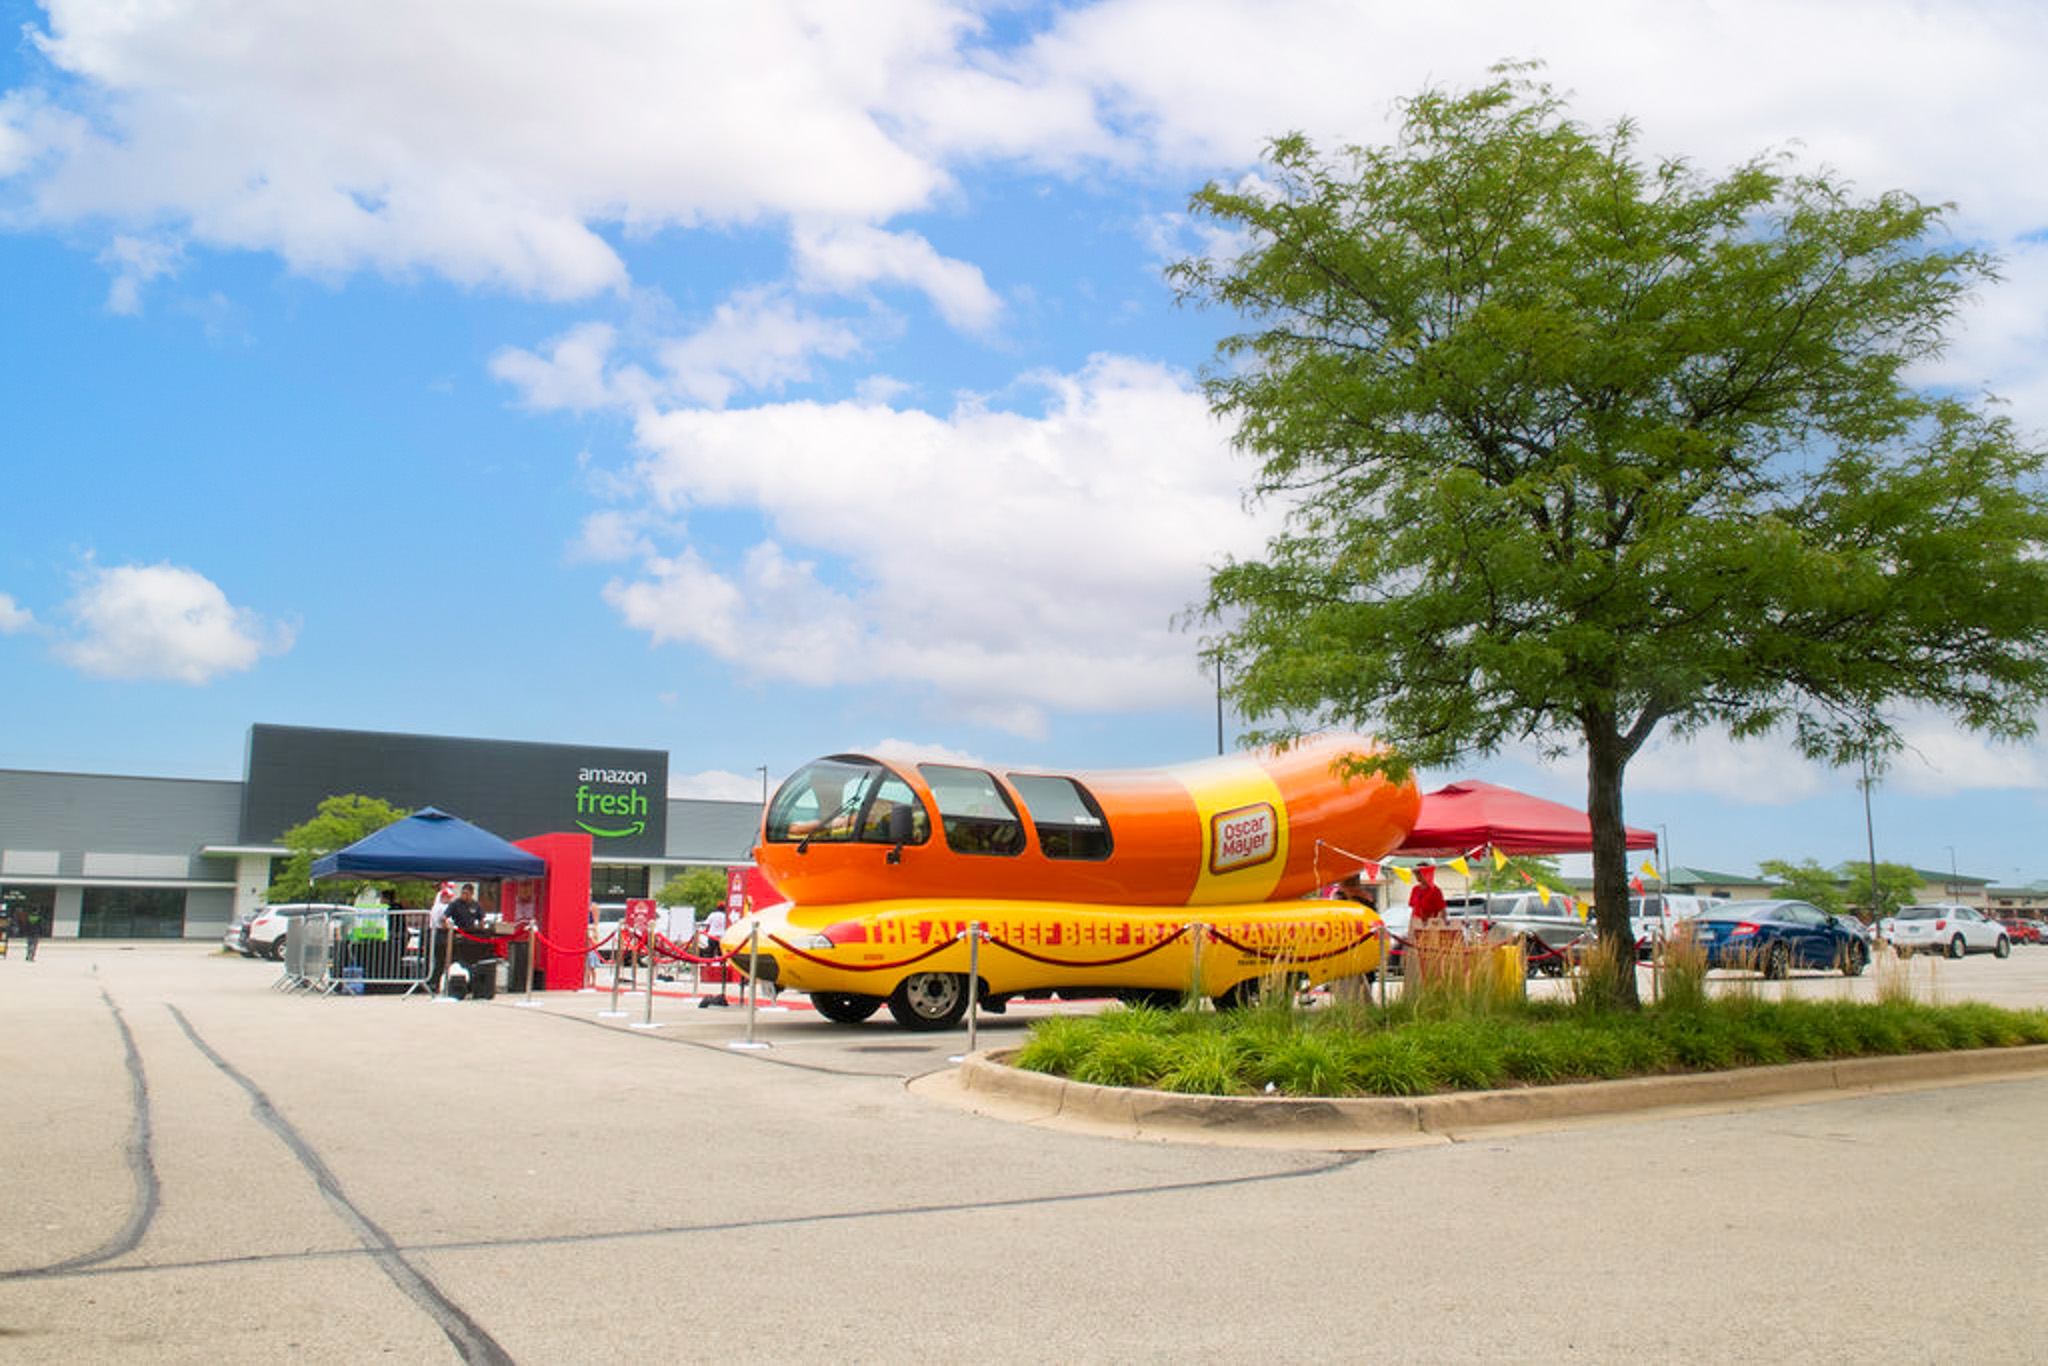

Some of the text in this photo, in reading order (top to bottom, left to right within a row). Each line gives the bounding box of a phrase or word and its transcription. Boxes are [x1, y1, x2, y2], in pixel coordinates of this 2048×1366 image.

[578, 767, 647, 784] amazon
[575, 785, 647, 816] fresh
[1224, 816, 1265, 840] Oscar
[1222, 832, 1268, 857] Mayer
[858, 919, 920, 943] THE
[988, 920, 1053, 944] BEEF
[1060, 921, 1122, 944] BEEF
